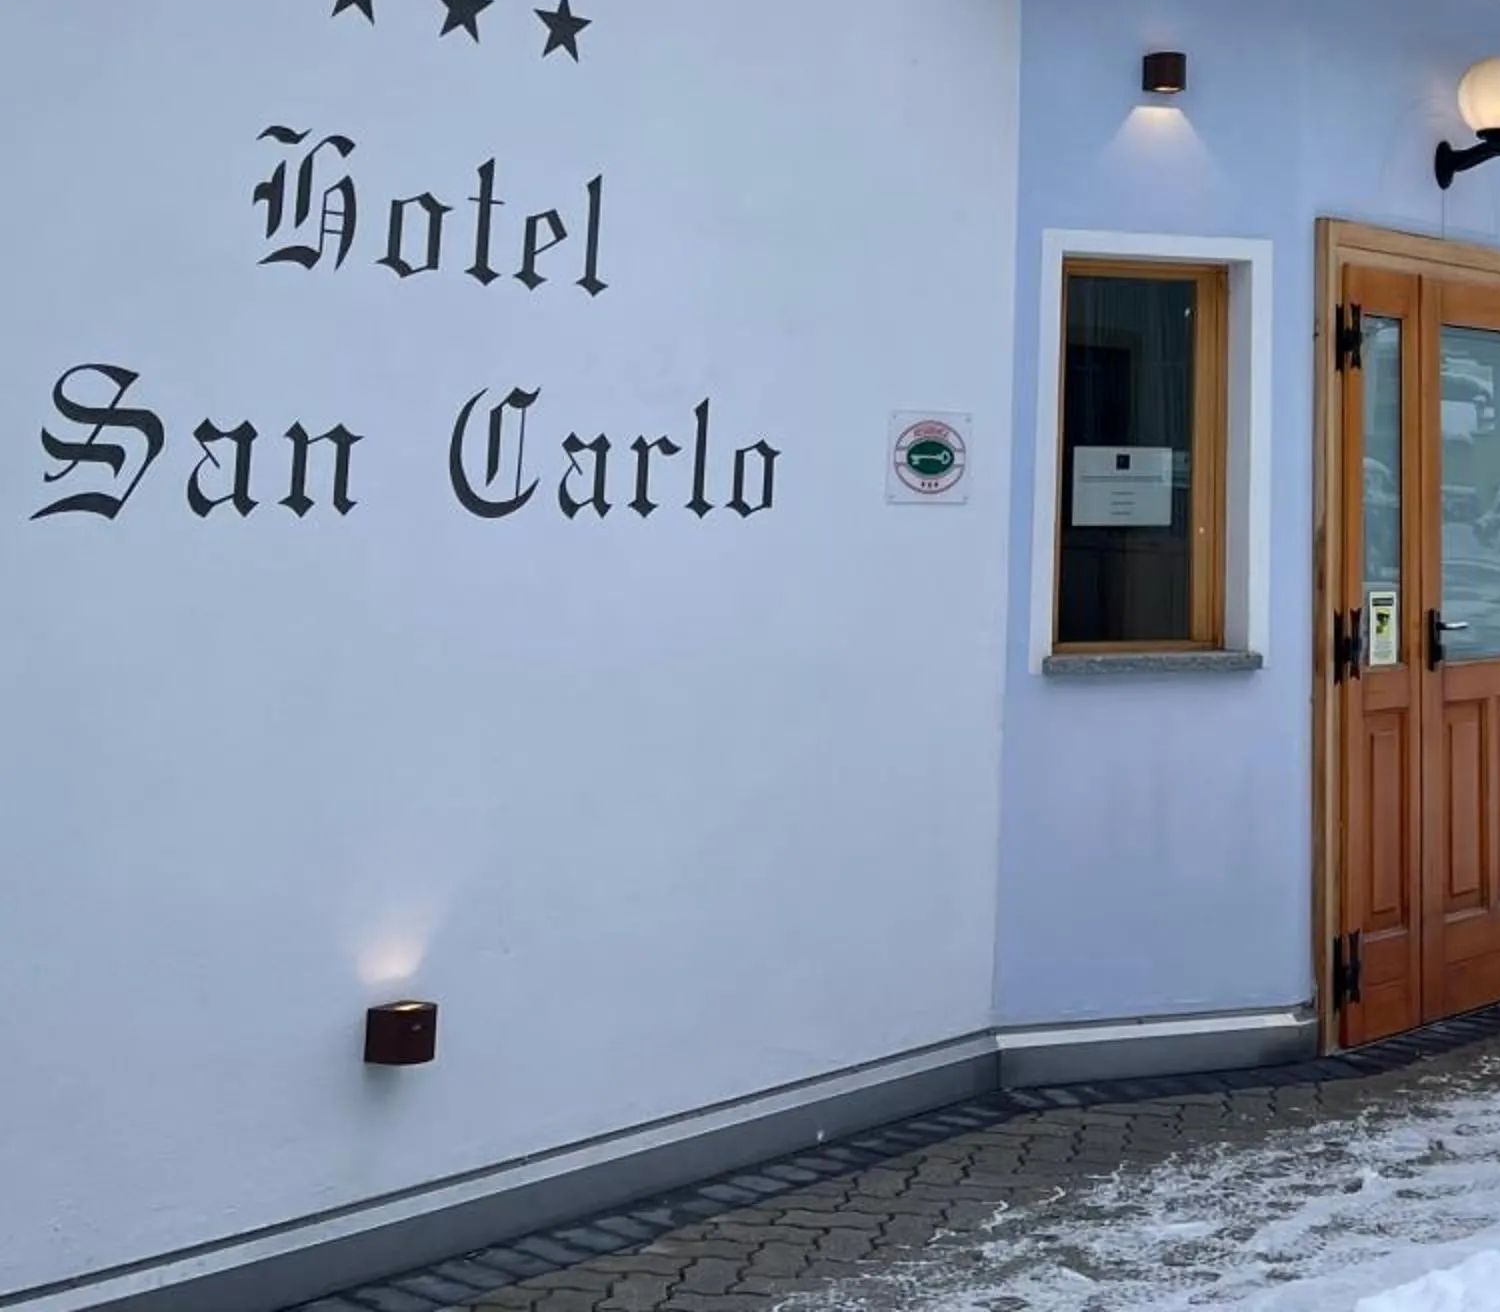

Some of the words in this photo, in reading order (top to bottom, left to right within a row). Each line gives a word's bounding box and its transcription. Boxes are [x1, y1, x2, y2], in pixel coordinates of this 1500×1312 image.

[253, 125, 608, 297] Hotel
[29, 363, 364, 520] San
[449, 386, 782, 520] Carlo
